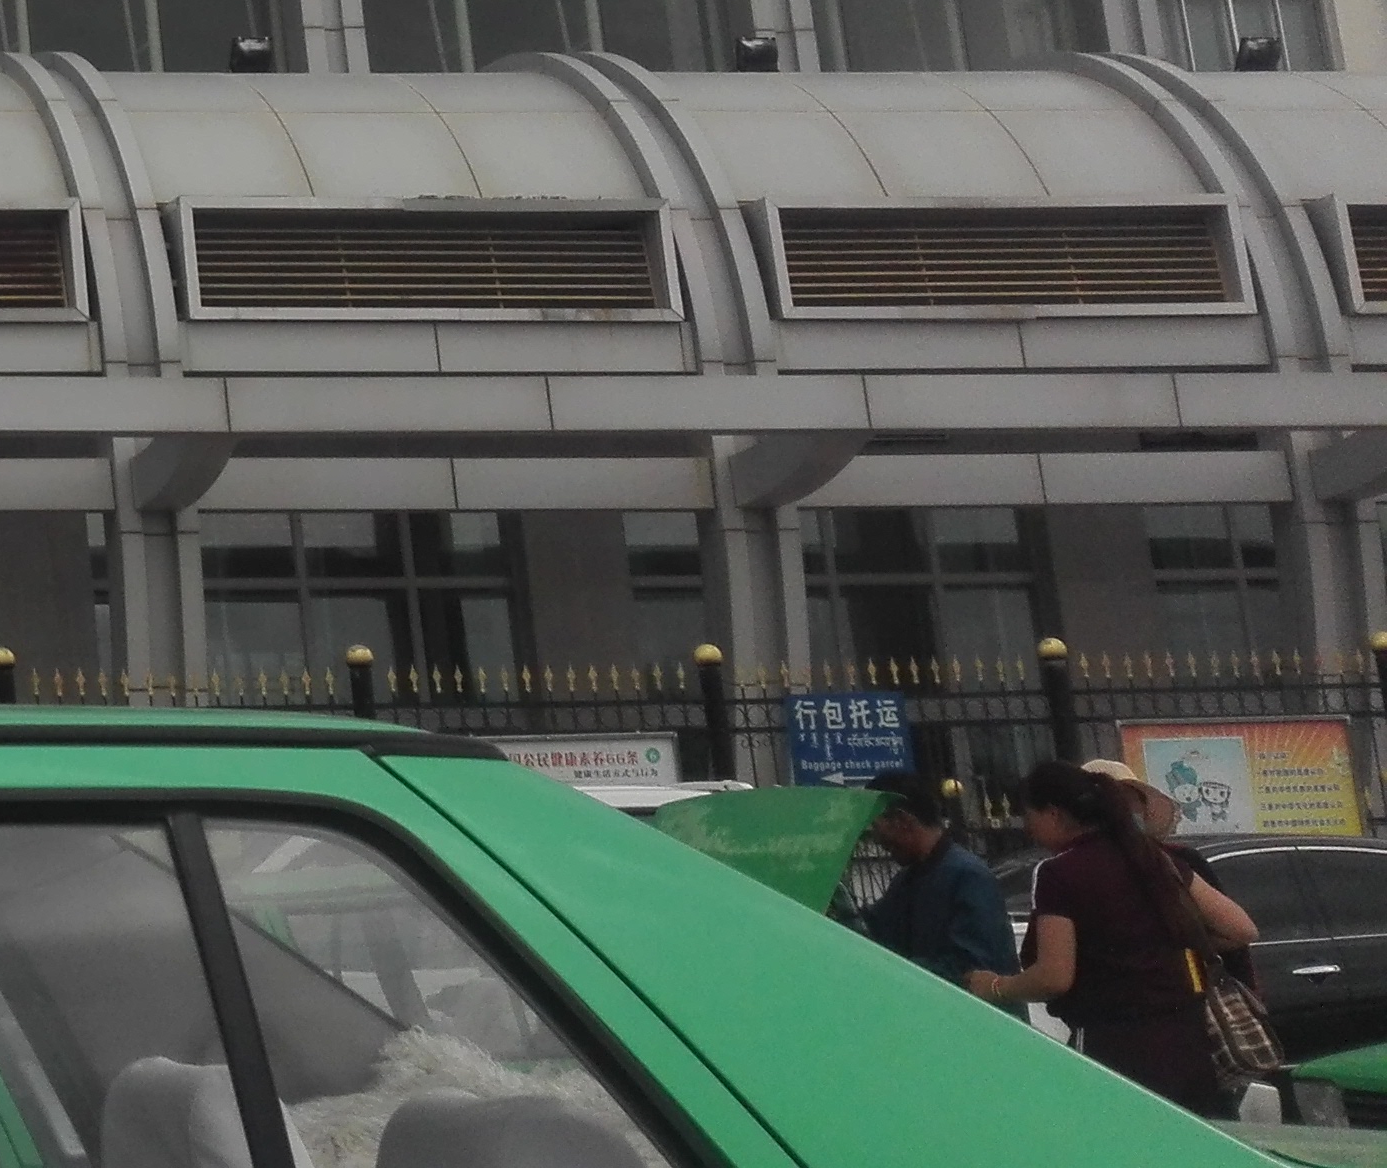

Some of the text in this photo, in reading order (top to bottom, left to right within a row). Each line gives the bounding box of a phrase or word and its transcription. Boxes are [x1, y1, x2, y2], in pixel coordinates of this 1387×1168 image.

[794, 699, 900, 730] 行包托运
[800, 758, 904, 772] Baggage check parcel
